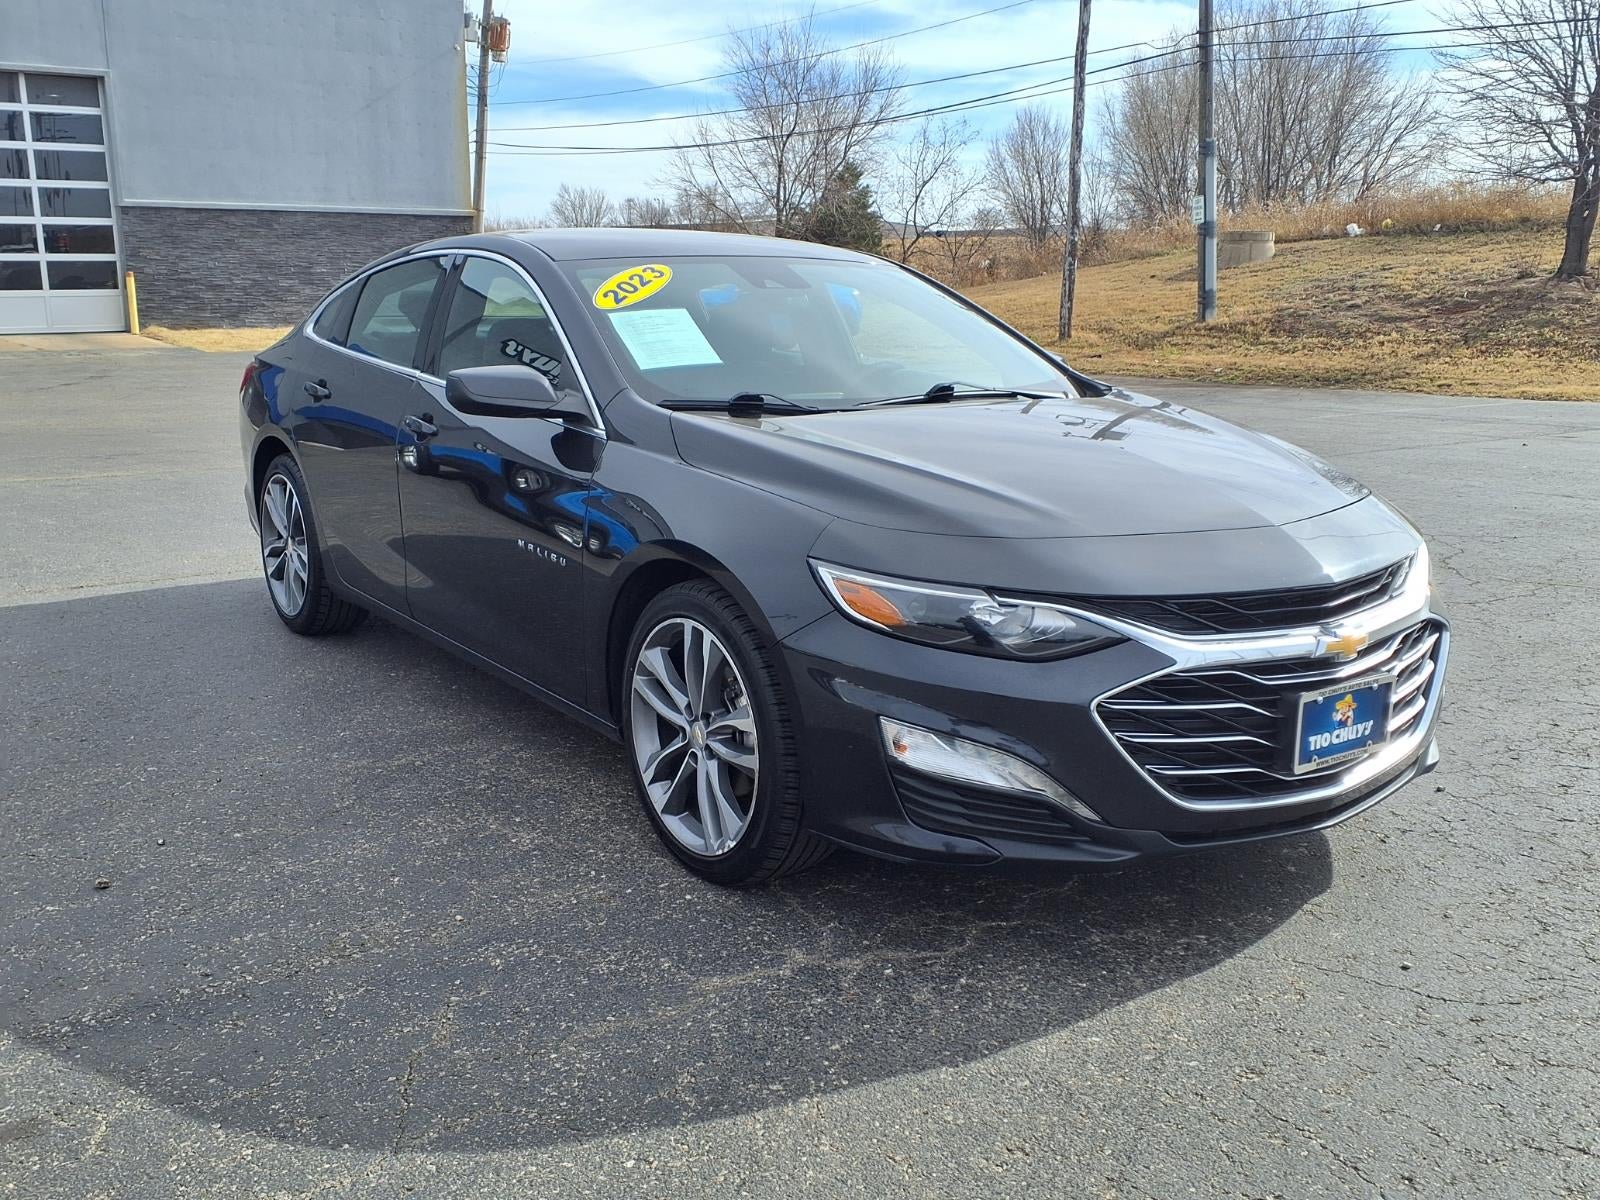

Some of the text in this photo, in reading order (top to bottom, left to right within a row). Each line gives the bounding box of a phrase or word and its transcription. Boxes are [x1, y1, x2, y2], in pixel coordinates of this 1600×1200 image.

[603, 267, 665, 305] 2023
[517, 539, 567, 567] MALIBU
[1309, 720, 1374, 751] TIO CHUY'S
